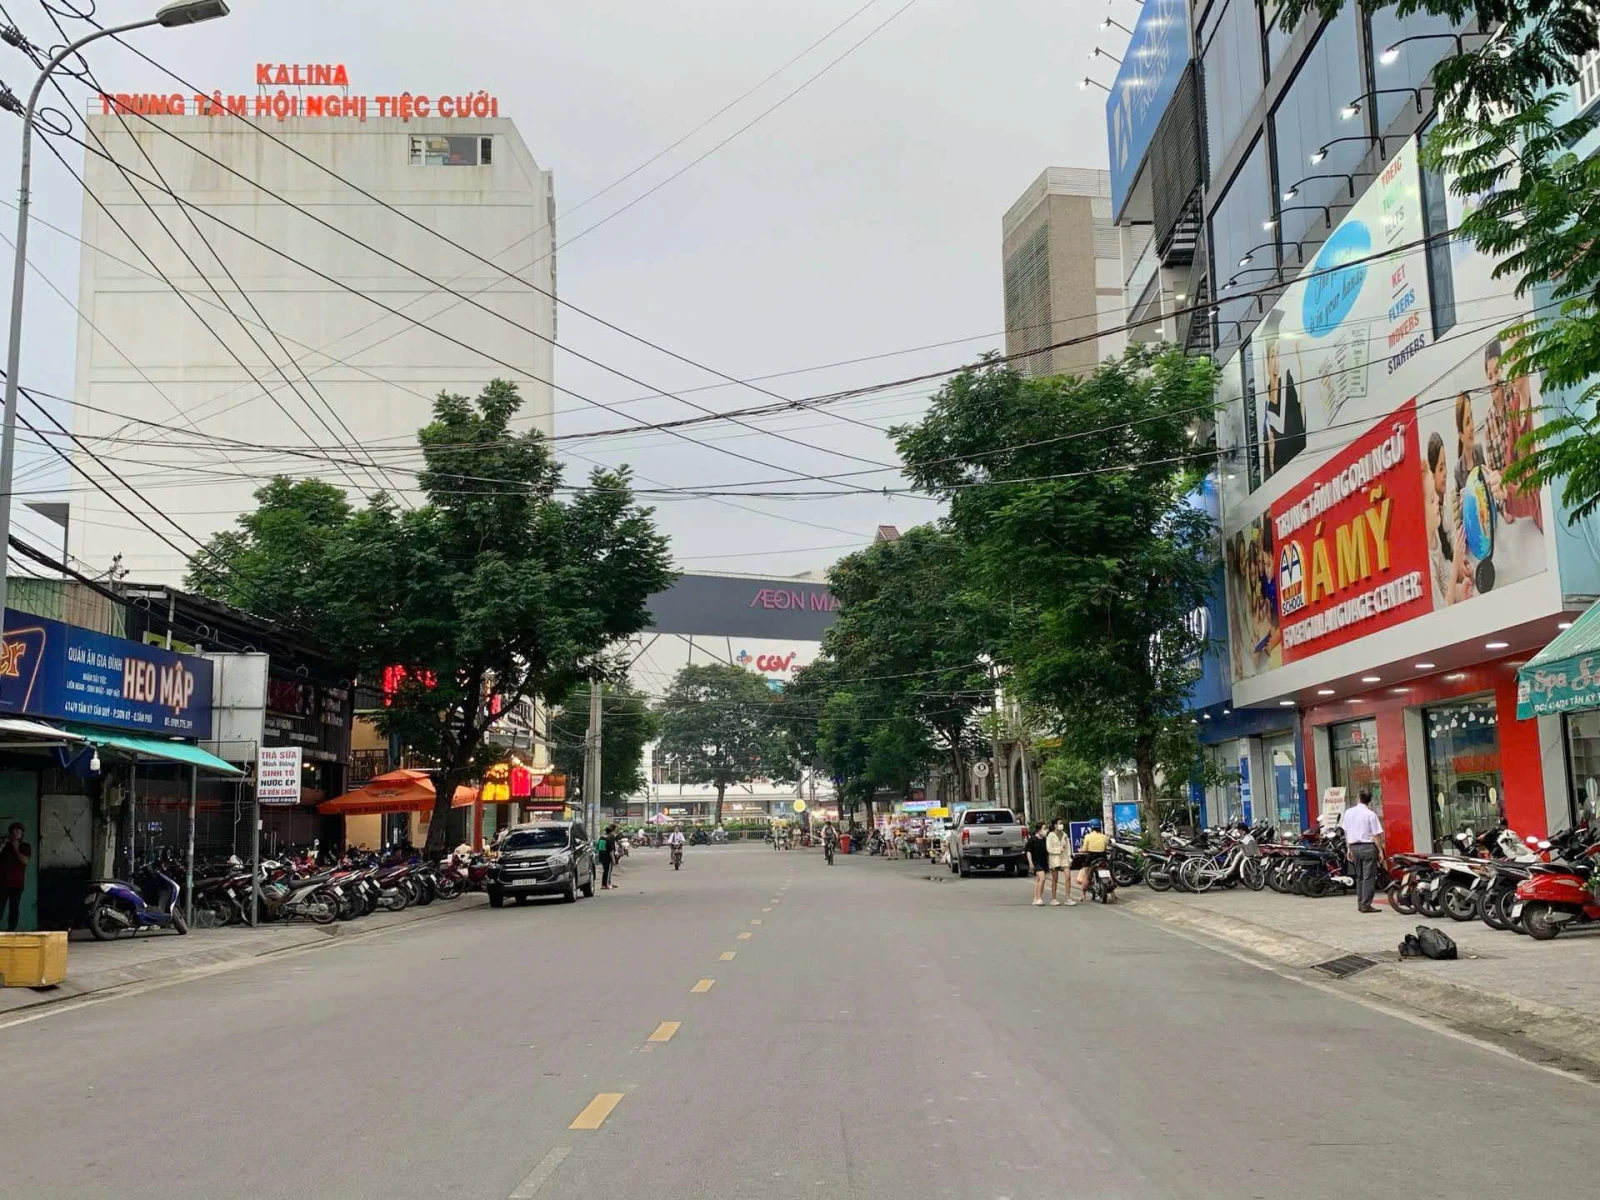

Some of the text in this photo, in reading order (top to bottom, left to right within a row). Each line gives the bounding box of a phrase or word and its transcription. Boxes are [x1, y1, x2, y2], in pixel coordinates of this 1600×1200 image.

[256, 63, 349, 86] KALINA
[99, 89, 499, 122] TRUNG TÂM HỘI NGHỊ TIỆC CƯỚI
[1381, 156, 1402, 188] TOEIC
[1391, 263, 1406, 288] KET
[1388, 288, 1415, 324] FLYERS
[1388, 312, 1419, 348] MOVERS
[1388, 334, 1425, 375] STARTERS
[1275, 422, 1406, 541] TRUNG TÂM NGOẠI NGỮ
[1312, 484, 1391, 602] Á MỸ
[810, 592, 842, 612] MA
[1282, 594, 1304, 615] SCHOOL
[1282, 571, 1423, 650] FOREIGN LANGUAGE CENTER
[68, 646, 123, 672] QUÁN ĂN GIA ĐÌNH
[756, 654, 791, 672] CGV
[123, 657, 194, 715] HEO MẬP
[1533, 669, 1568, 702] Spa
[261, 750, 277, 759] TRÀ
[260, 778, 296, 787] NƯỚC ÉP
